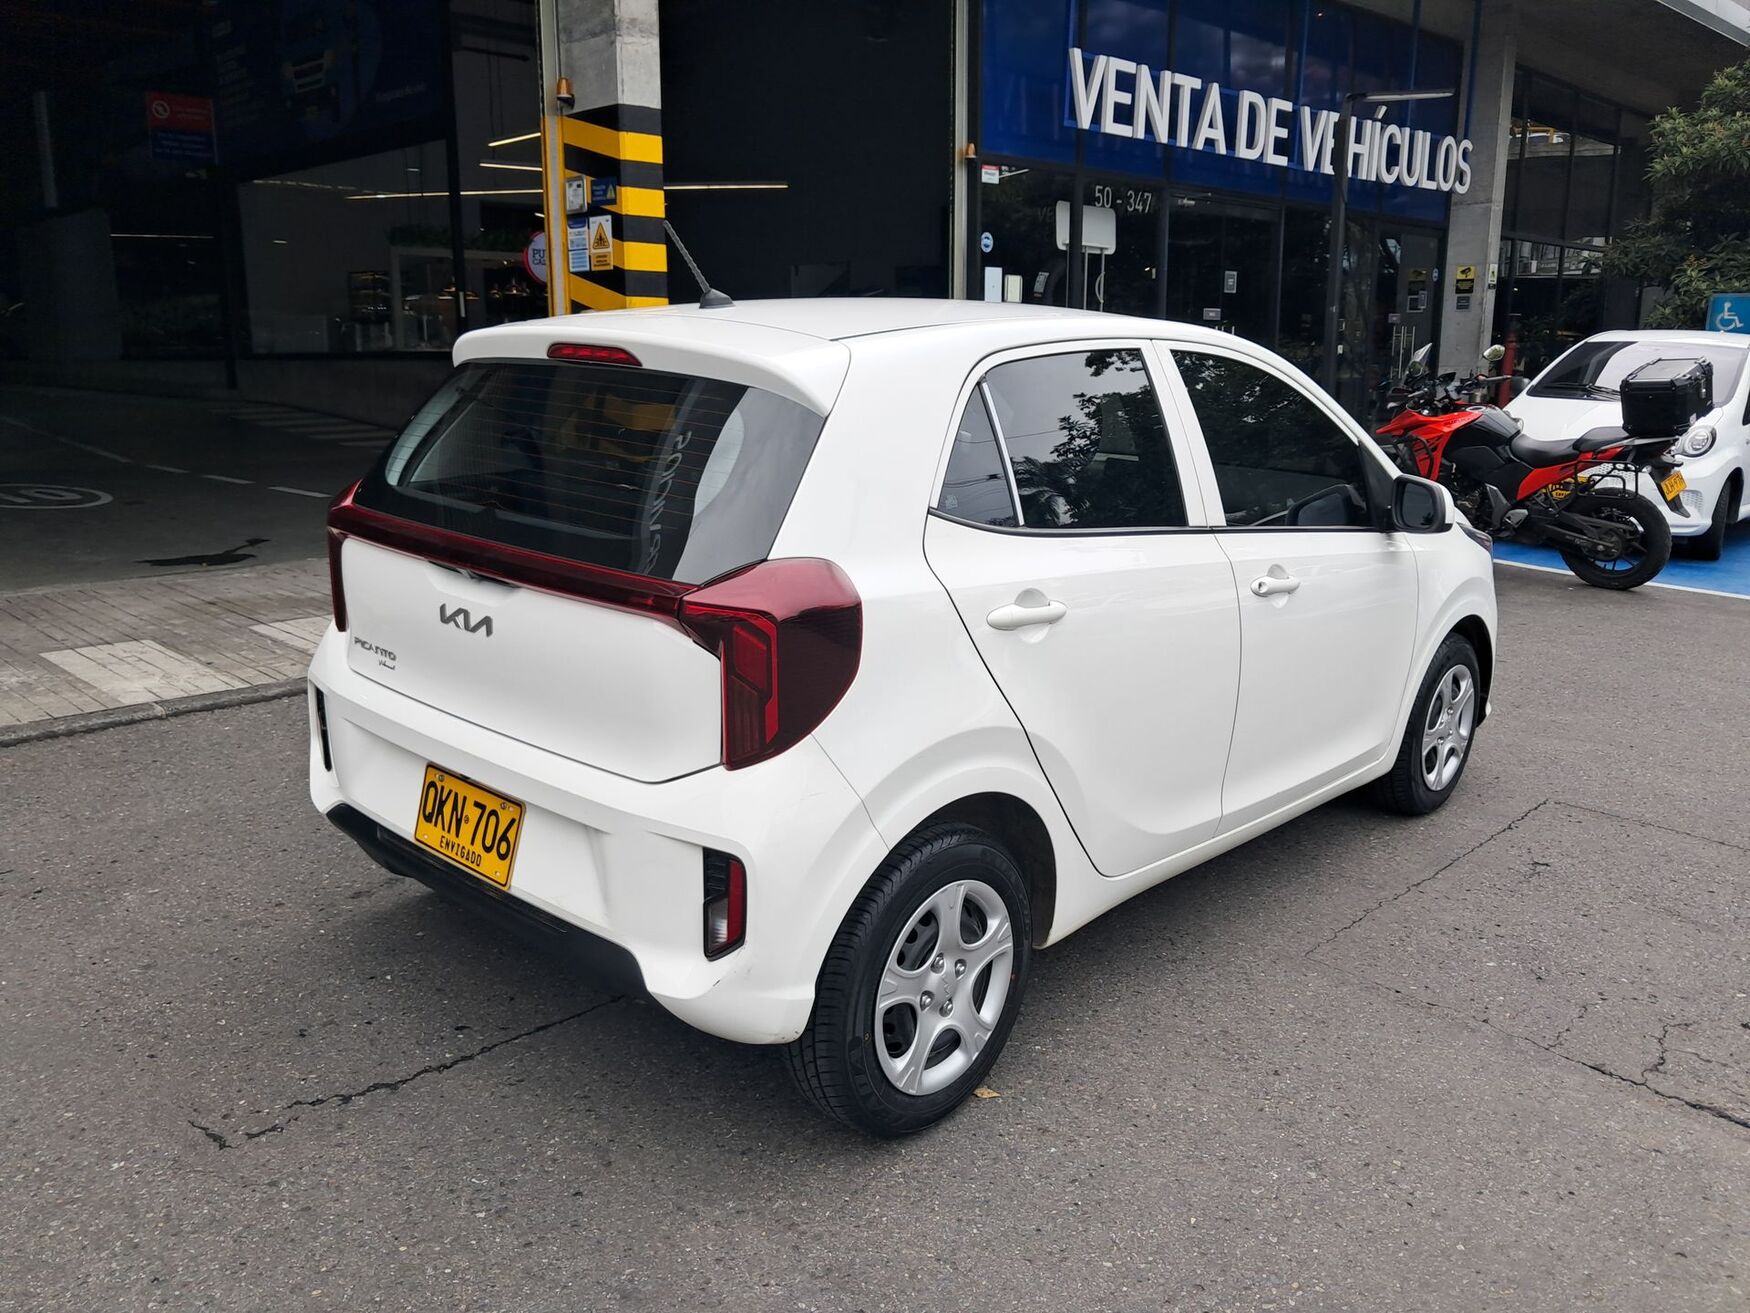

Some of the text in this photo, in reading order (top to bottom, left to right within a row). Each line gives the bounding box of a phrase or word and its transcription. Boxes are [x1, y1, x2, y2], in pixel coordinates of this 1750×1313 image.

[1069, 47, 1473, 194] VENTA DE VEHÍCULOS
[1095, 185, 1112, 208] 50
[1127, 190, 1152, 213] 347
[439, 603, 493, 638] KIA
[354, 636, 397, 660] PICANTO
[422, 780, 517, 861] QKN 706
[440, 835, 482, 867] ENVIGADO
